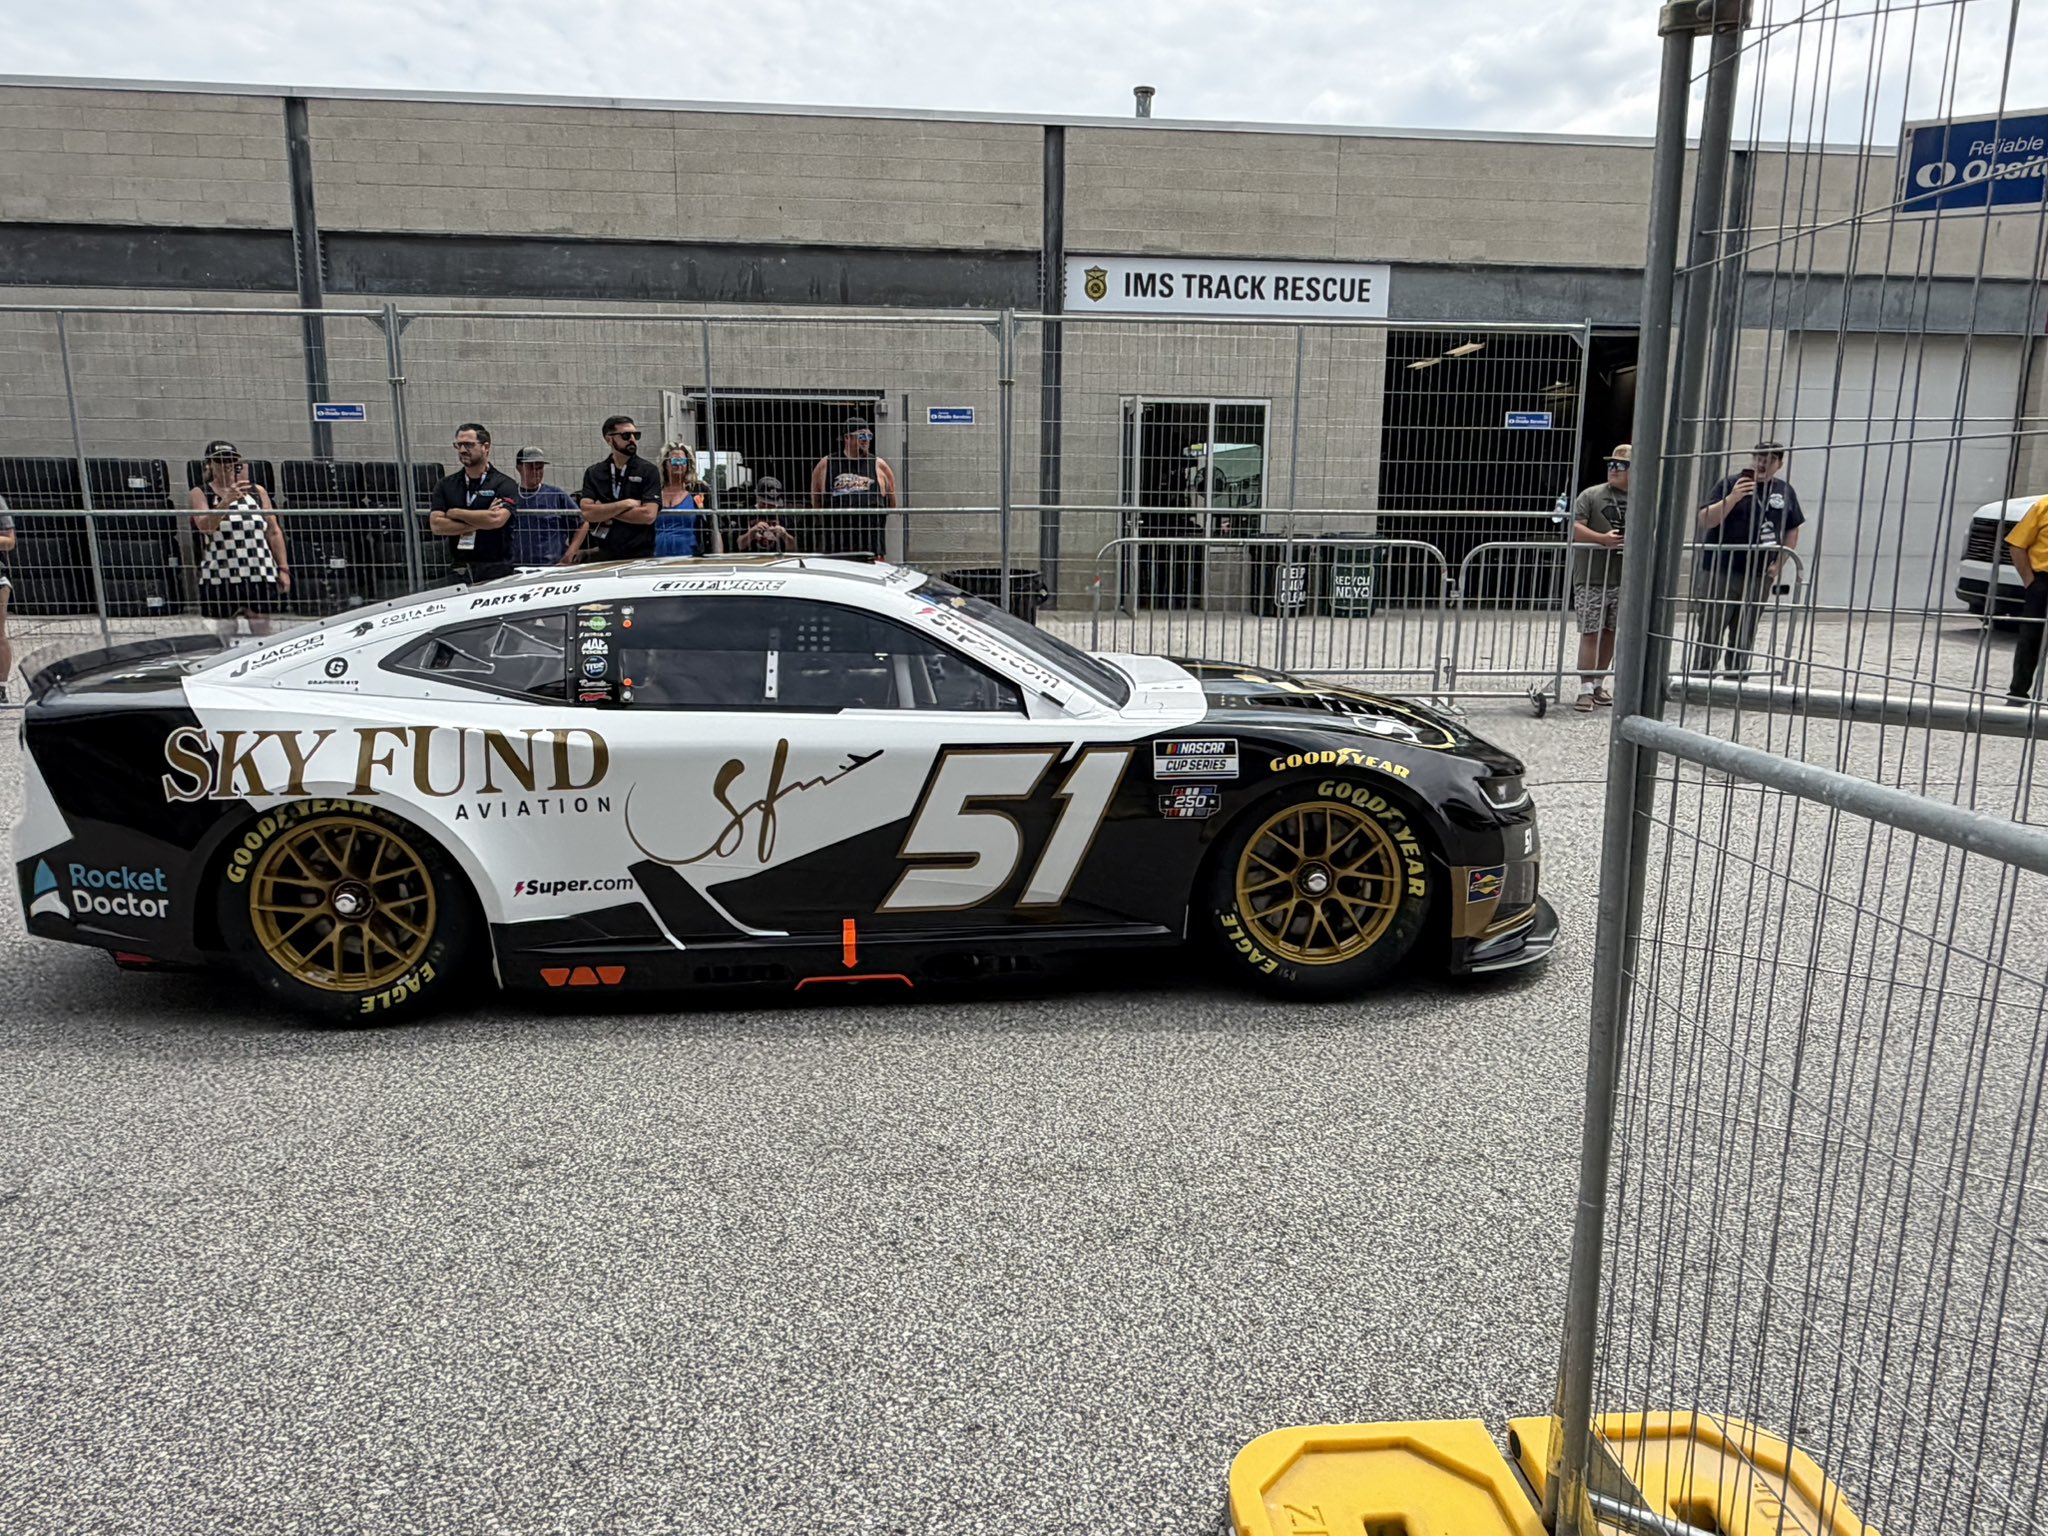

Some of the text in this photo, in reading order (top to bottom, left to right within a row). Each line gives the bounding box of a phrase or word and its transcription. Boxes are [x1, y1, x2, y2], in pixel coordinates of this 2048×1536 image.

[1969, 136, 2044, 157] Reiable
[1125, 272, 1372, 303] IMS TRACK RESCUE
[1334, 575, 1371, 587] RECYCL
[469, 584, 581, 610] PARTS PLUS
[381, 610, 422, 624] COSTA
[252, 634, 324, 664] JACOB
[1180, 742, 1225, 754] NASCAR
[162, 726, 610, 803] SKY FUND
[1165, 759, 1227, 771] CUP SERIES
[1270, 749, 1410, 778] GOODYEAR
[455, 796, 611, 821] AVIATION
[1173, 796, 1207, 808] 250
[875, 743, 1136, 913] 51
[1318, 780, 1426, 897] GOODYEAR
[68, 863, 168, 892] Rocket
[525, 878, 634, 896] Super.com
[71, 889, 170, 918] Doctor
[1220, 914, 1279, 974] EAGLE
[360, 962, 437, 1014] EAGLE
